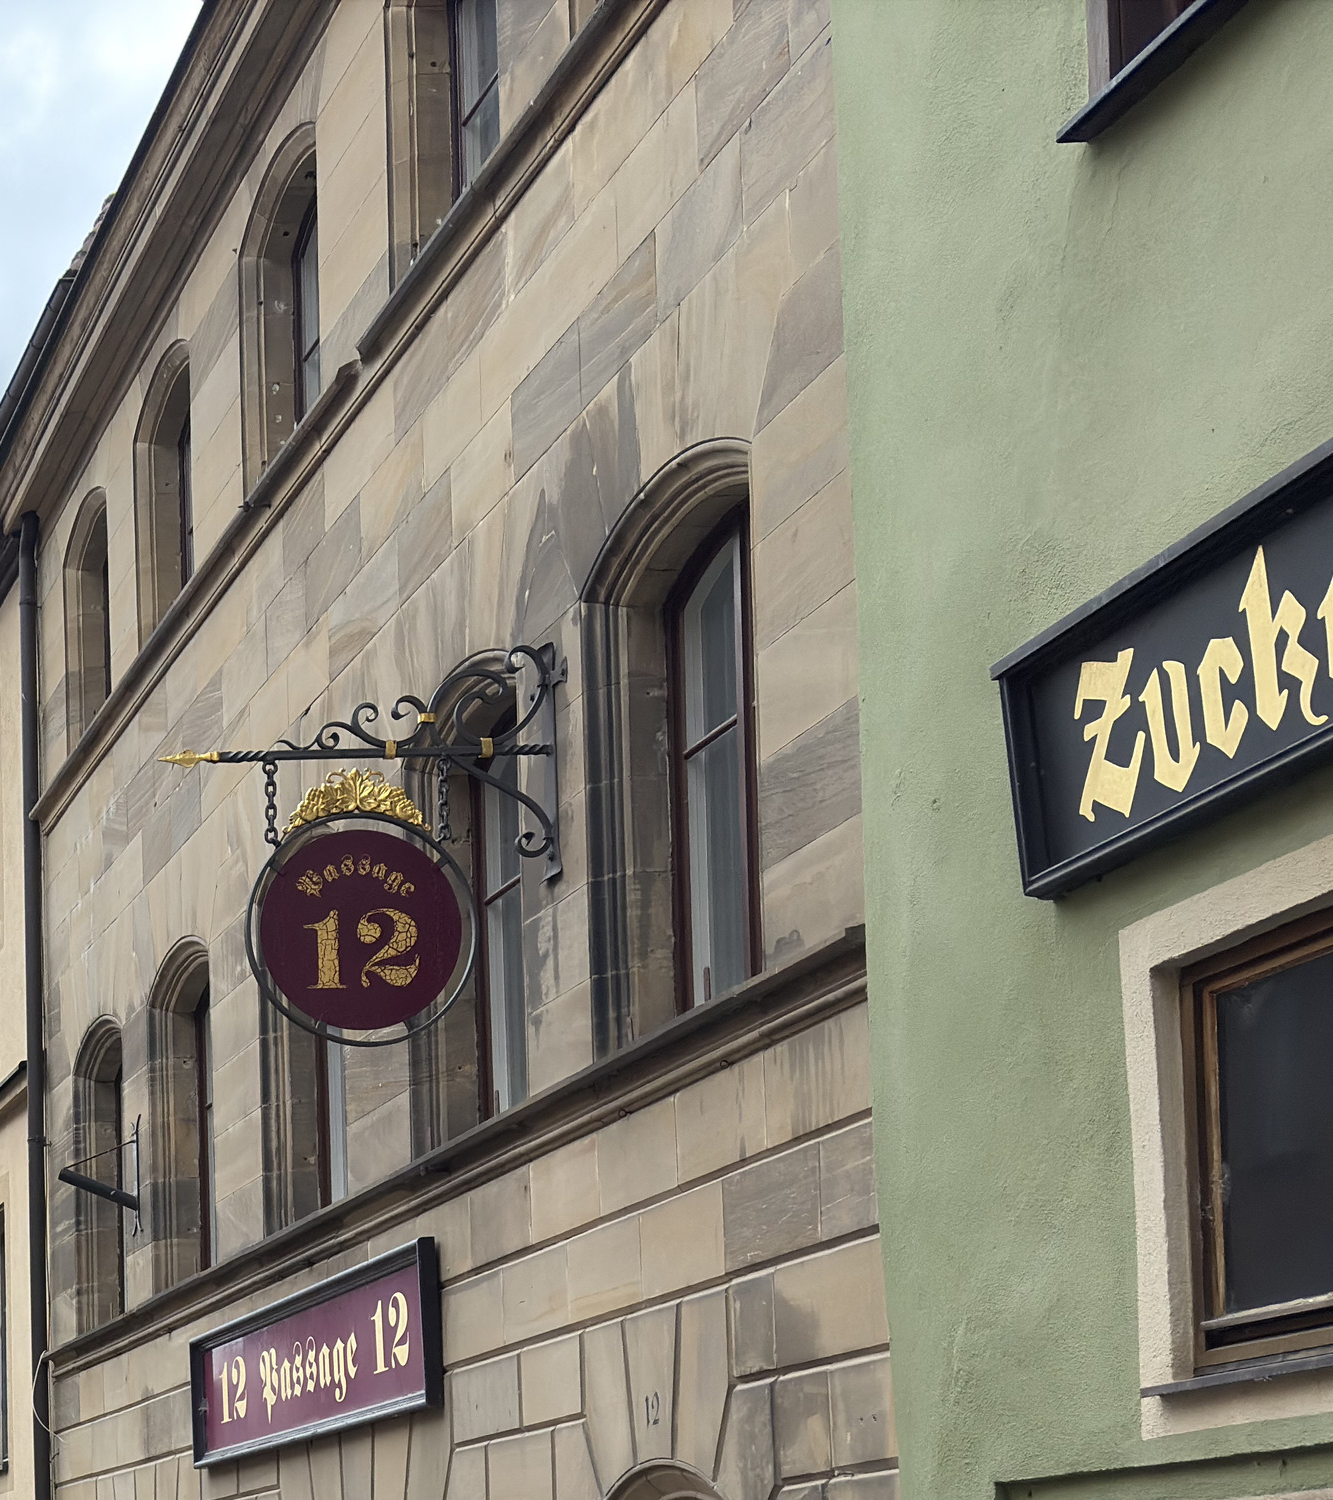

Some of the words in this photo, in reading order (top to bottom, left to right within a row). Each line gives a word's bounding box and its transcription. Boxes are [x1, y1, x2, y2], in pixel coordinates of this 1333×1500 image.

[296, 854, 415, 897] Passage
[303, 908, 420, 988] 12
[219, 1356, 248, 1424] 12
[259, 1332, 358, 1424] Passage
[370, 1291, 410, 1375] 12
[644, 1391, 660, 1429] 12
